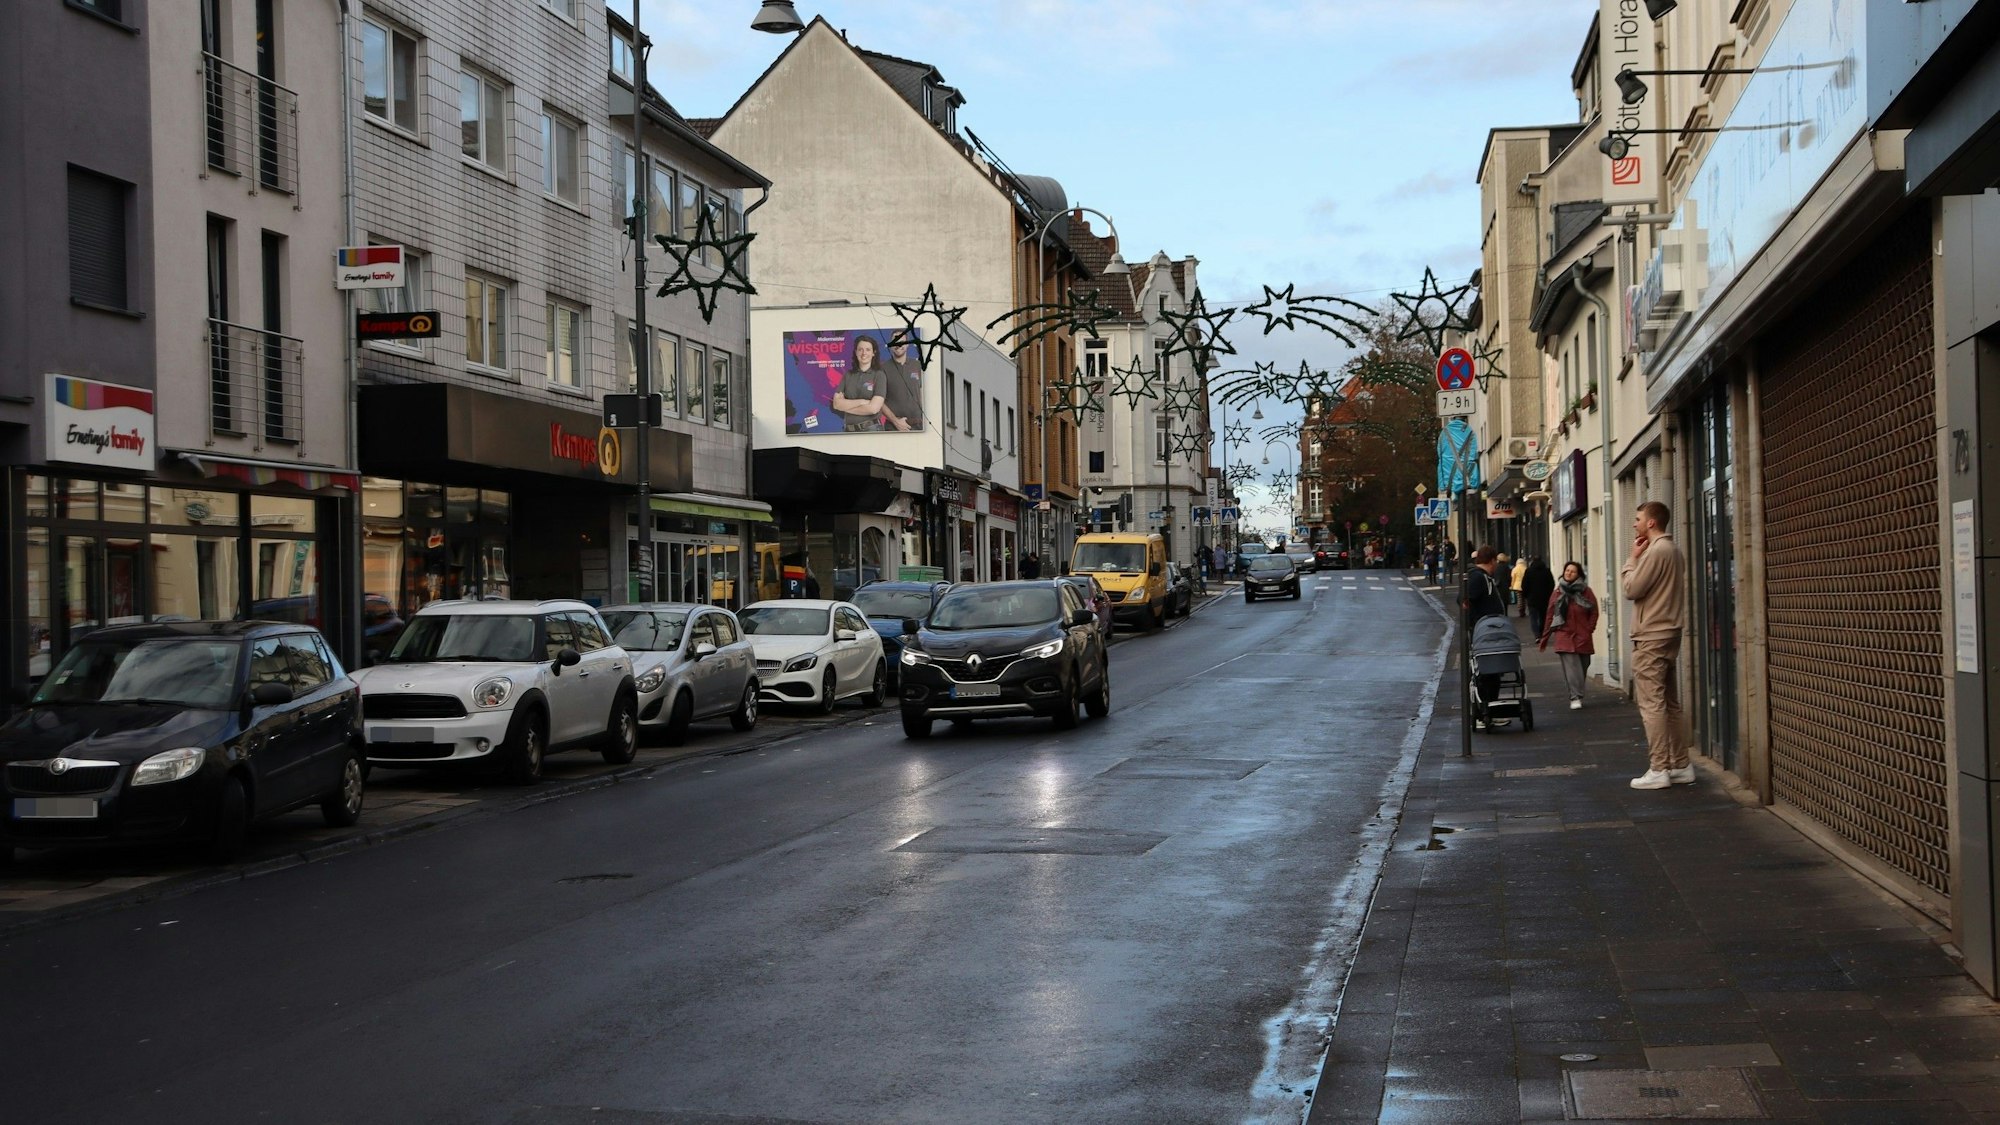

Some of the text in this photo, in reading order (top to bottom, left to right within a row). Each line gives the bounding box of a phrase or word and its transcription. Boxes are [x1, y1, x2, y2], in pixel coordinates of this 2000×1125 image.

[372, 272, 395, 281] family
[361, 320, 407, 333] Kamps
[787, 341, 846, 354] wissner
[67, 424, 145, 456] Ernsting's family
[551, 423, 597, 469] Kamps
[1494, 502, 1511, 510] dm
[790, 580, 798, 591] P
